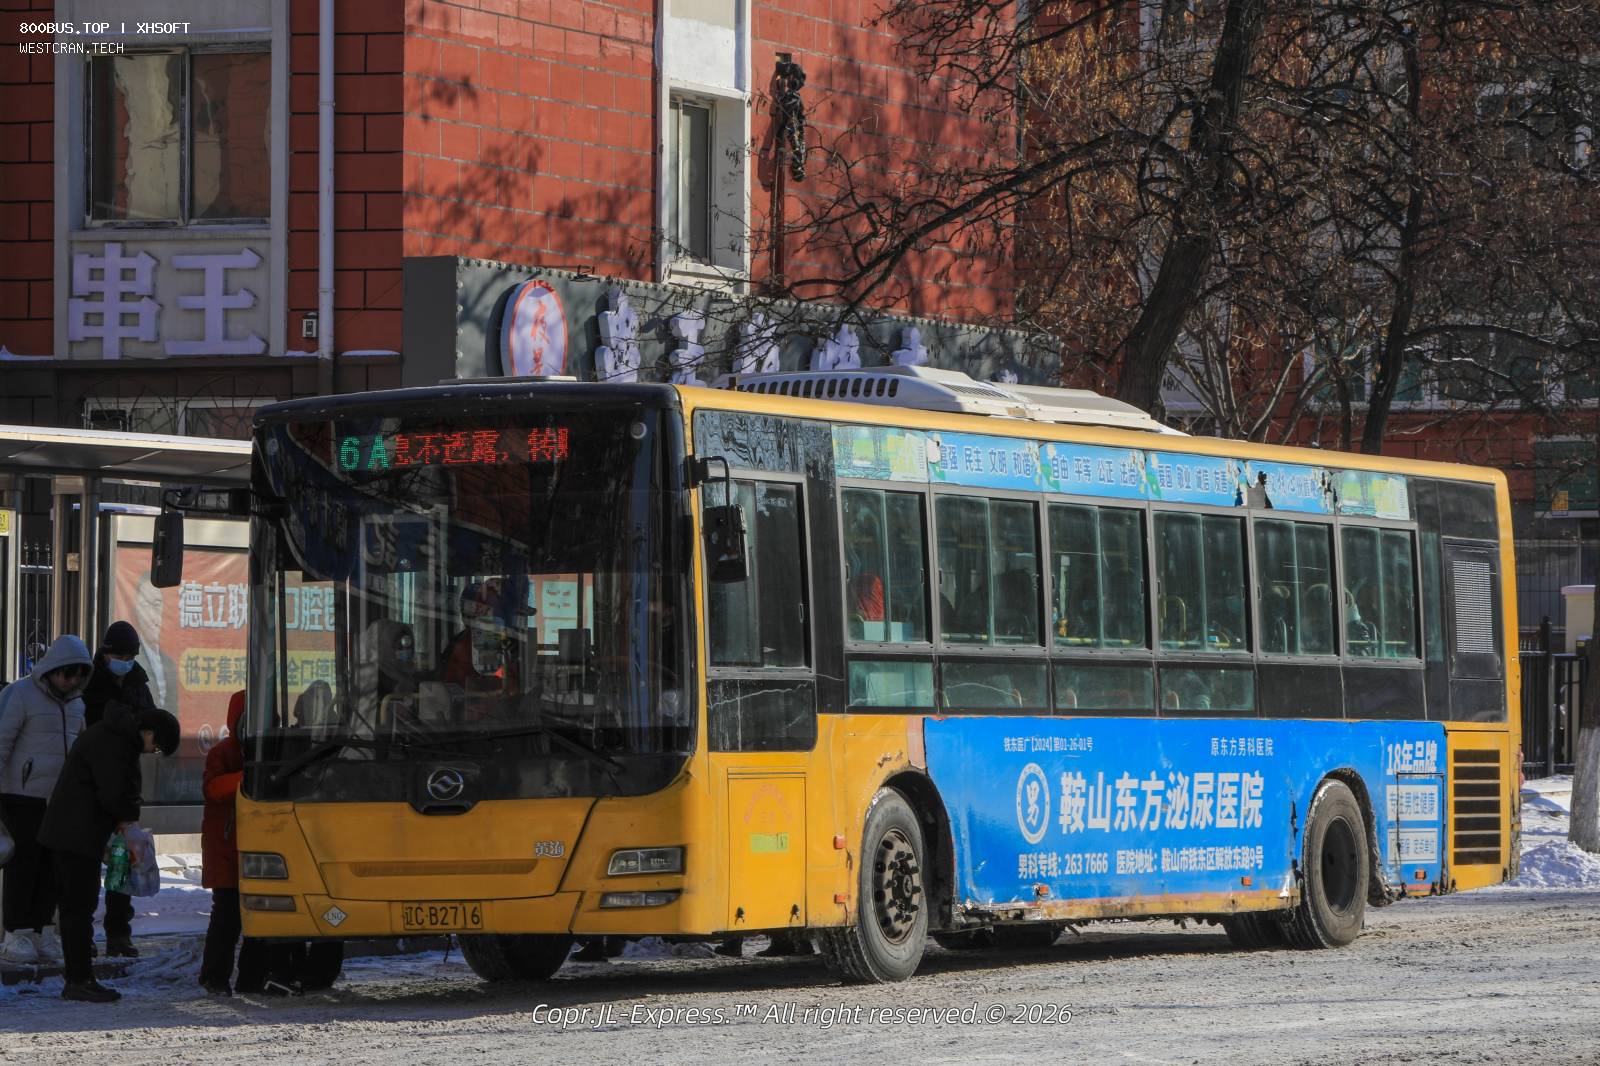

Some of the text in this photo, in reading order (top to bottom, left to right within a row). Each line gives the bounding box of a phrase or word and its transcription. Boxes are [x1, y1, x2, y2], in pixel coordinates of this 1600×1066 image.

[69, 242, 267, 360] 串王
[940, 444, 959, 472] 富强
[964, 446, 983, 473] 民主
[988, 449, 1008, 475] 文明
[1012, 450, 1032, 478] 和谐
[1052, 455, 1069, 481] 自由
[1074, 456, 1092, 483] 平等
[1096, 458, 1114, 485] 公正
[1211, 737, 1273, 756] 原东方男科医院
[1387, 740, 1438, 779] 18年品牌
[1059, 770, 1264, 834] 鞍山东方泌尿医院
[1085, 852, 1108, 874] 7666
